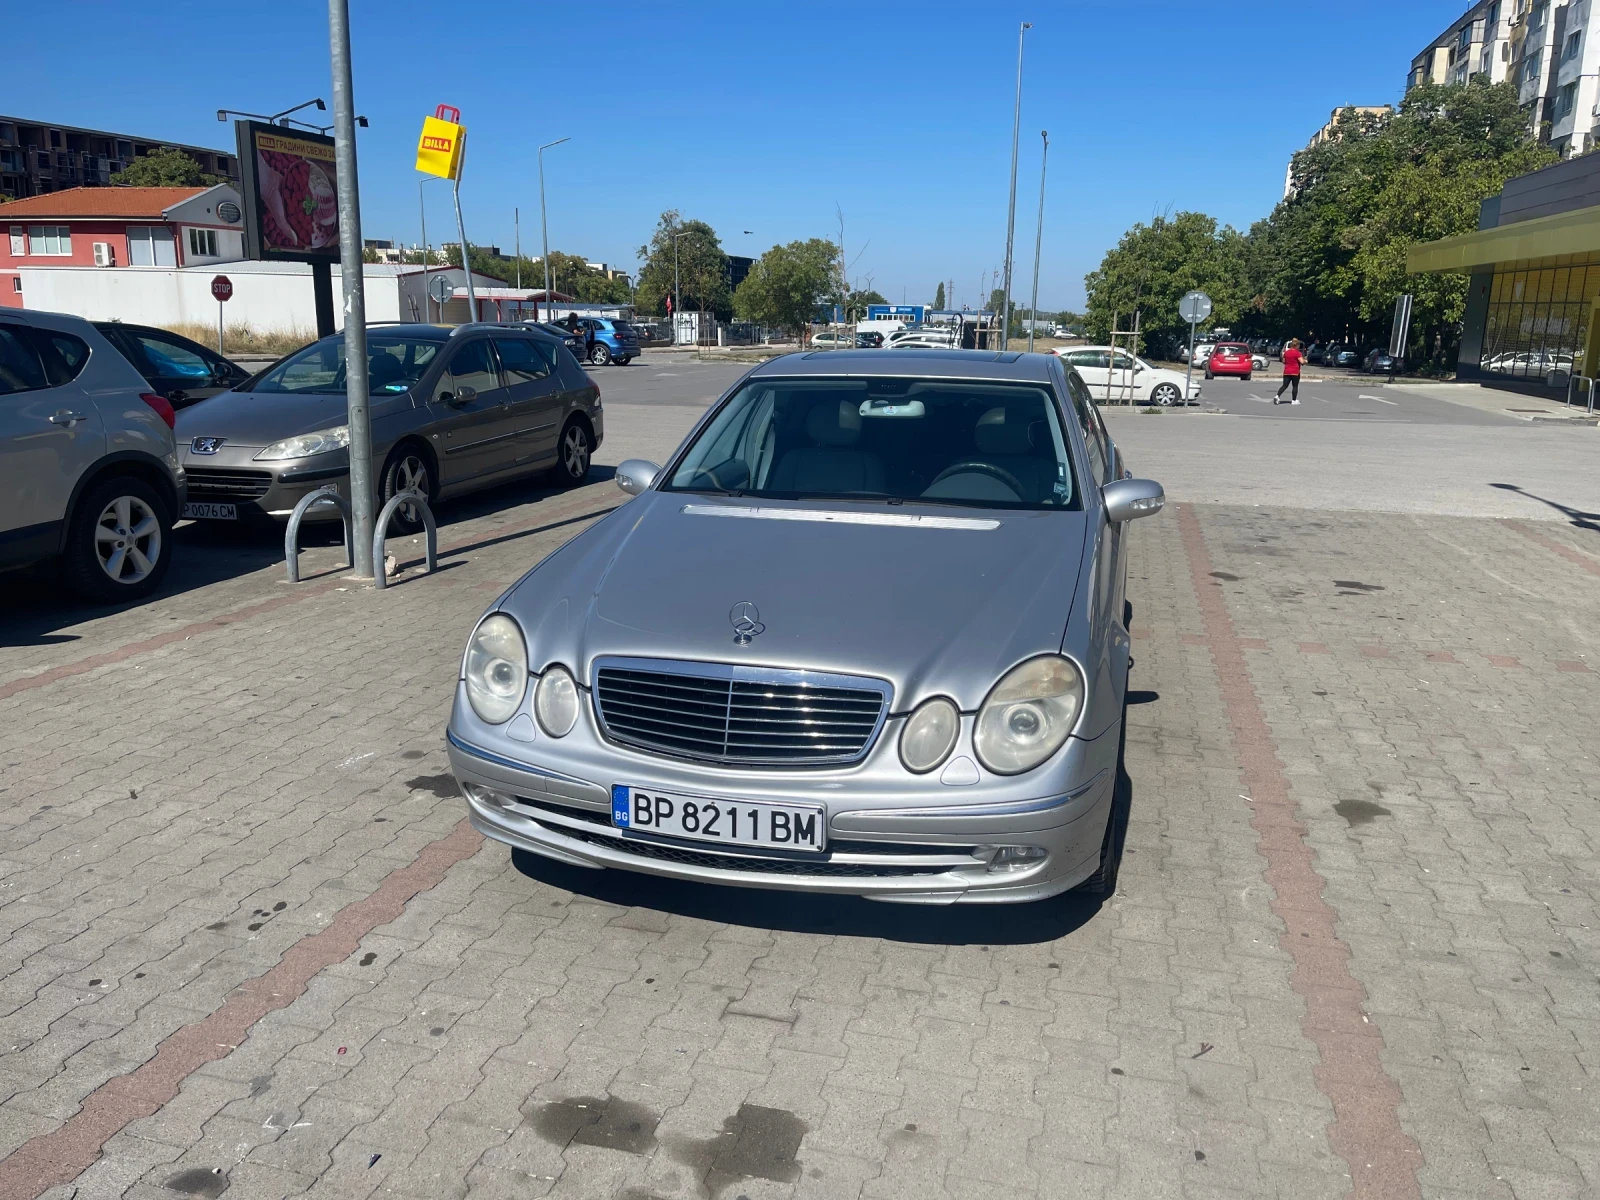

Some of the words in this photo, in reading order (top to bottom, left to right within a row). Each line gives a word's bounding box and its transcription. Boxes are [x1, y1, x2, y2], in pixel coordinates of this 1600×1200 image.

[276, 139, 306, 153] ГРАДИНИ
[306, 145, 328, 157] СВЕЖО
[423, 137, 449, 150] BILLA
[213, 283, 231, 293] STOP
[191, 504, 218, 517] 0076
[219, 505, 235, 518] CM
[615, 810, 628, 821] BG
[634, 793, 674, 828] BP
[681, 801, 759, 841] 8211
[770, 810, 816, 846] BM
